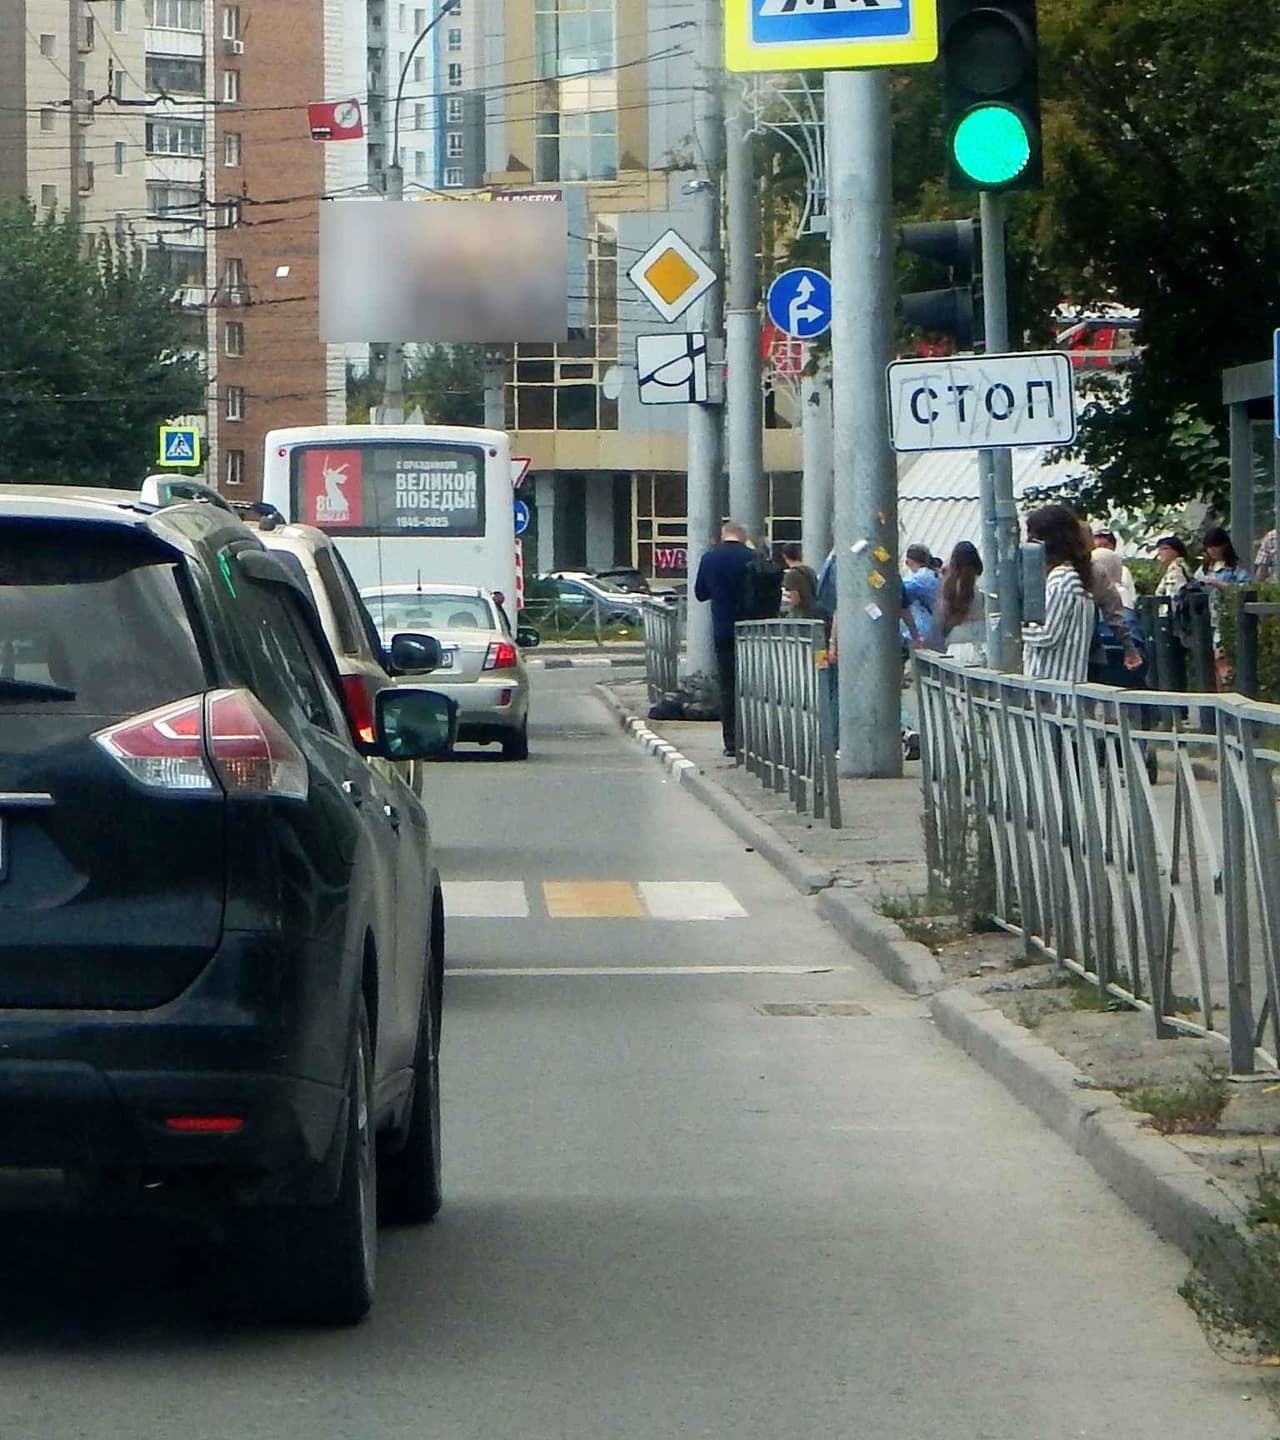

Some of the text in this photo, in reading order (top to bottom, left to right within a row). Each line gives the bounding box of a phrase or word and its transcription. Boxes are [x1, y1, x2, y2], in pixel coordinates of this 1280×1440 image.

[909, 380, 1056, 425] СТОП
[395, 471, 477, 491] ВЕЛИКОЙ
[395, 491, 477, 512] ПОБЕДЫ!
